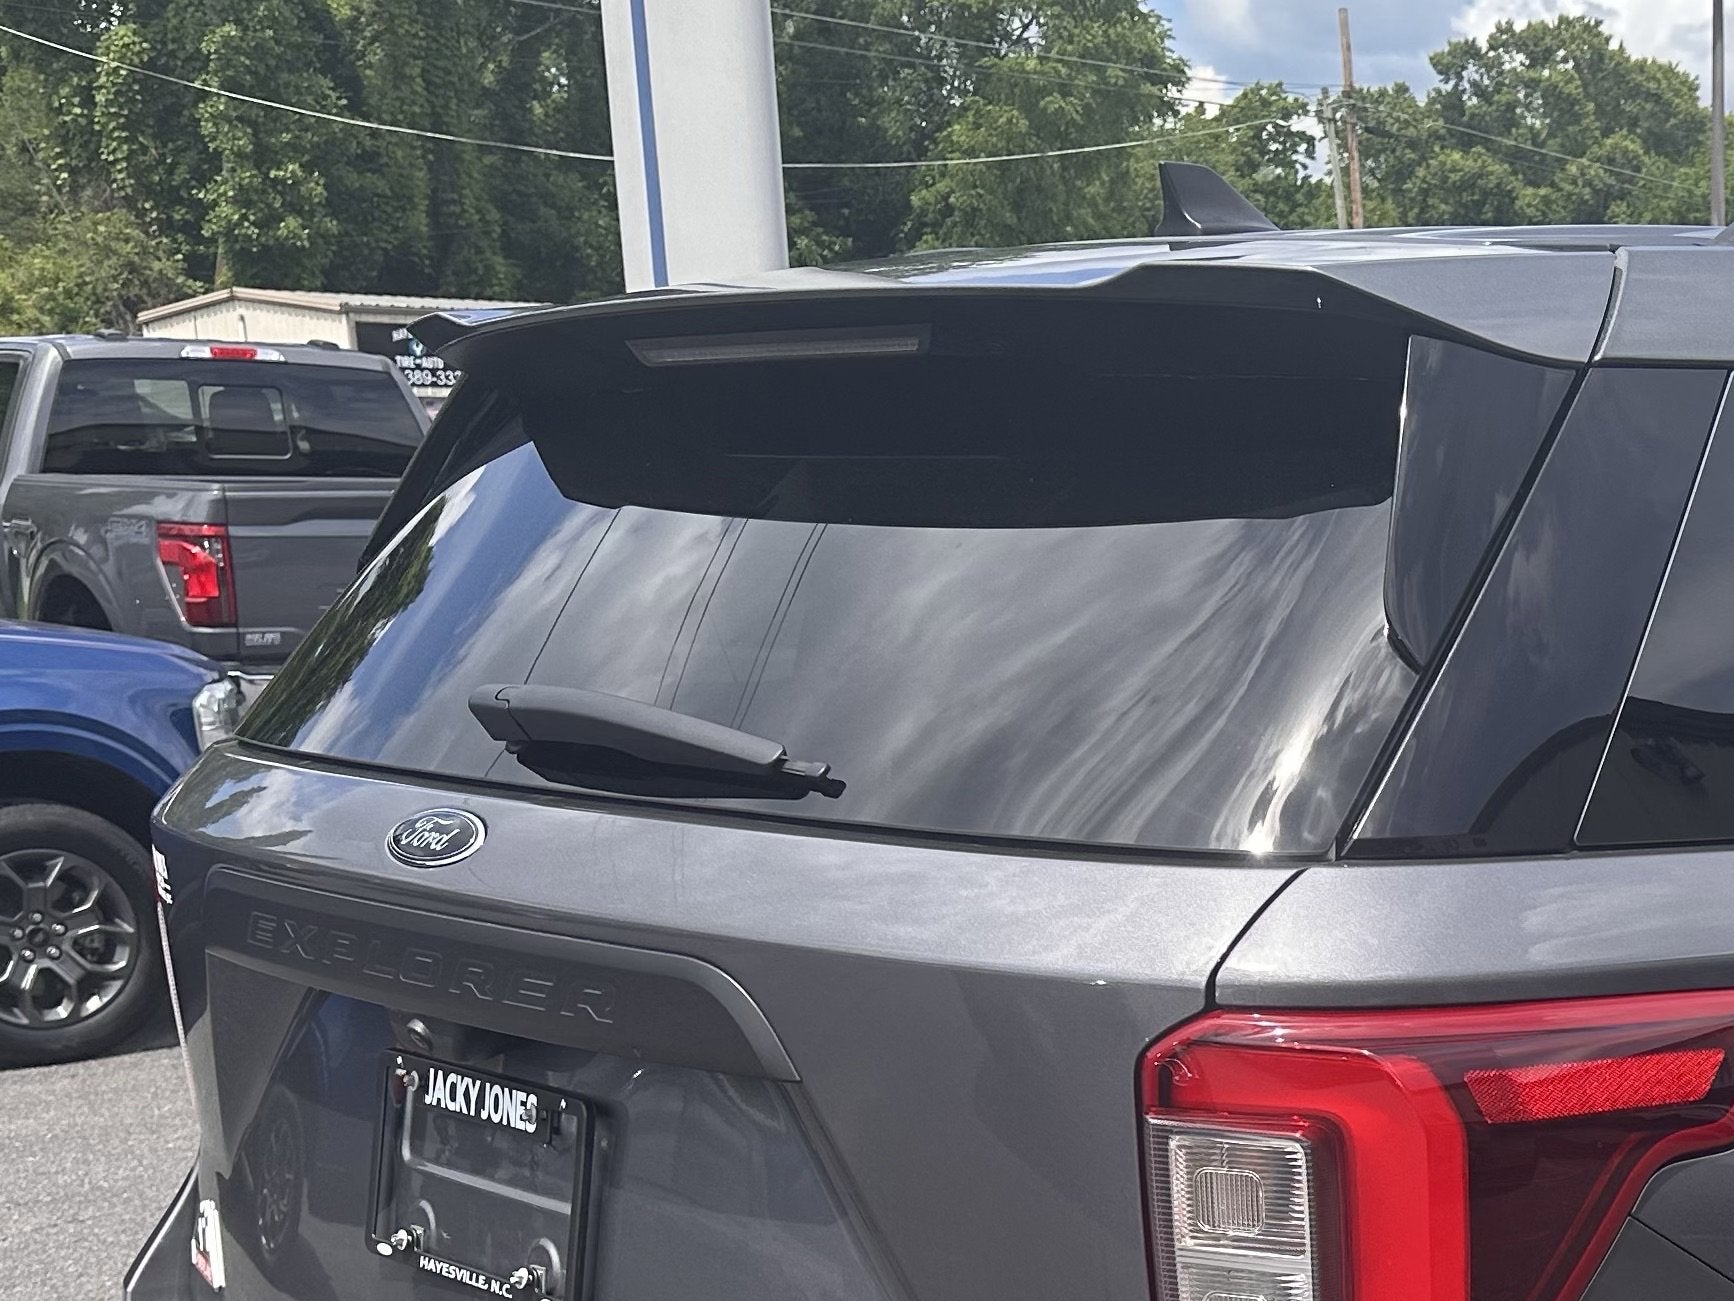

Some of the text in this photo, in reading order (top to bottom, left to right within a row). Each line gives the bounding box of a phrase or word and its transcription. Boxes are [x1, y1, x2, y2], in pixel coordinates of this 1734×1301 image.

[400, 815, 461, 851] Ford
[246, 910, 615, 1023] EXPLORER
[424, 1067, 538, 1134] JACKY JONES
